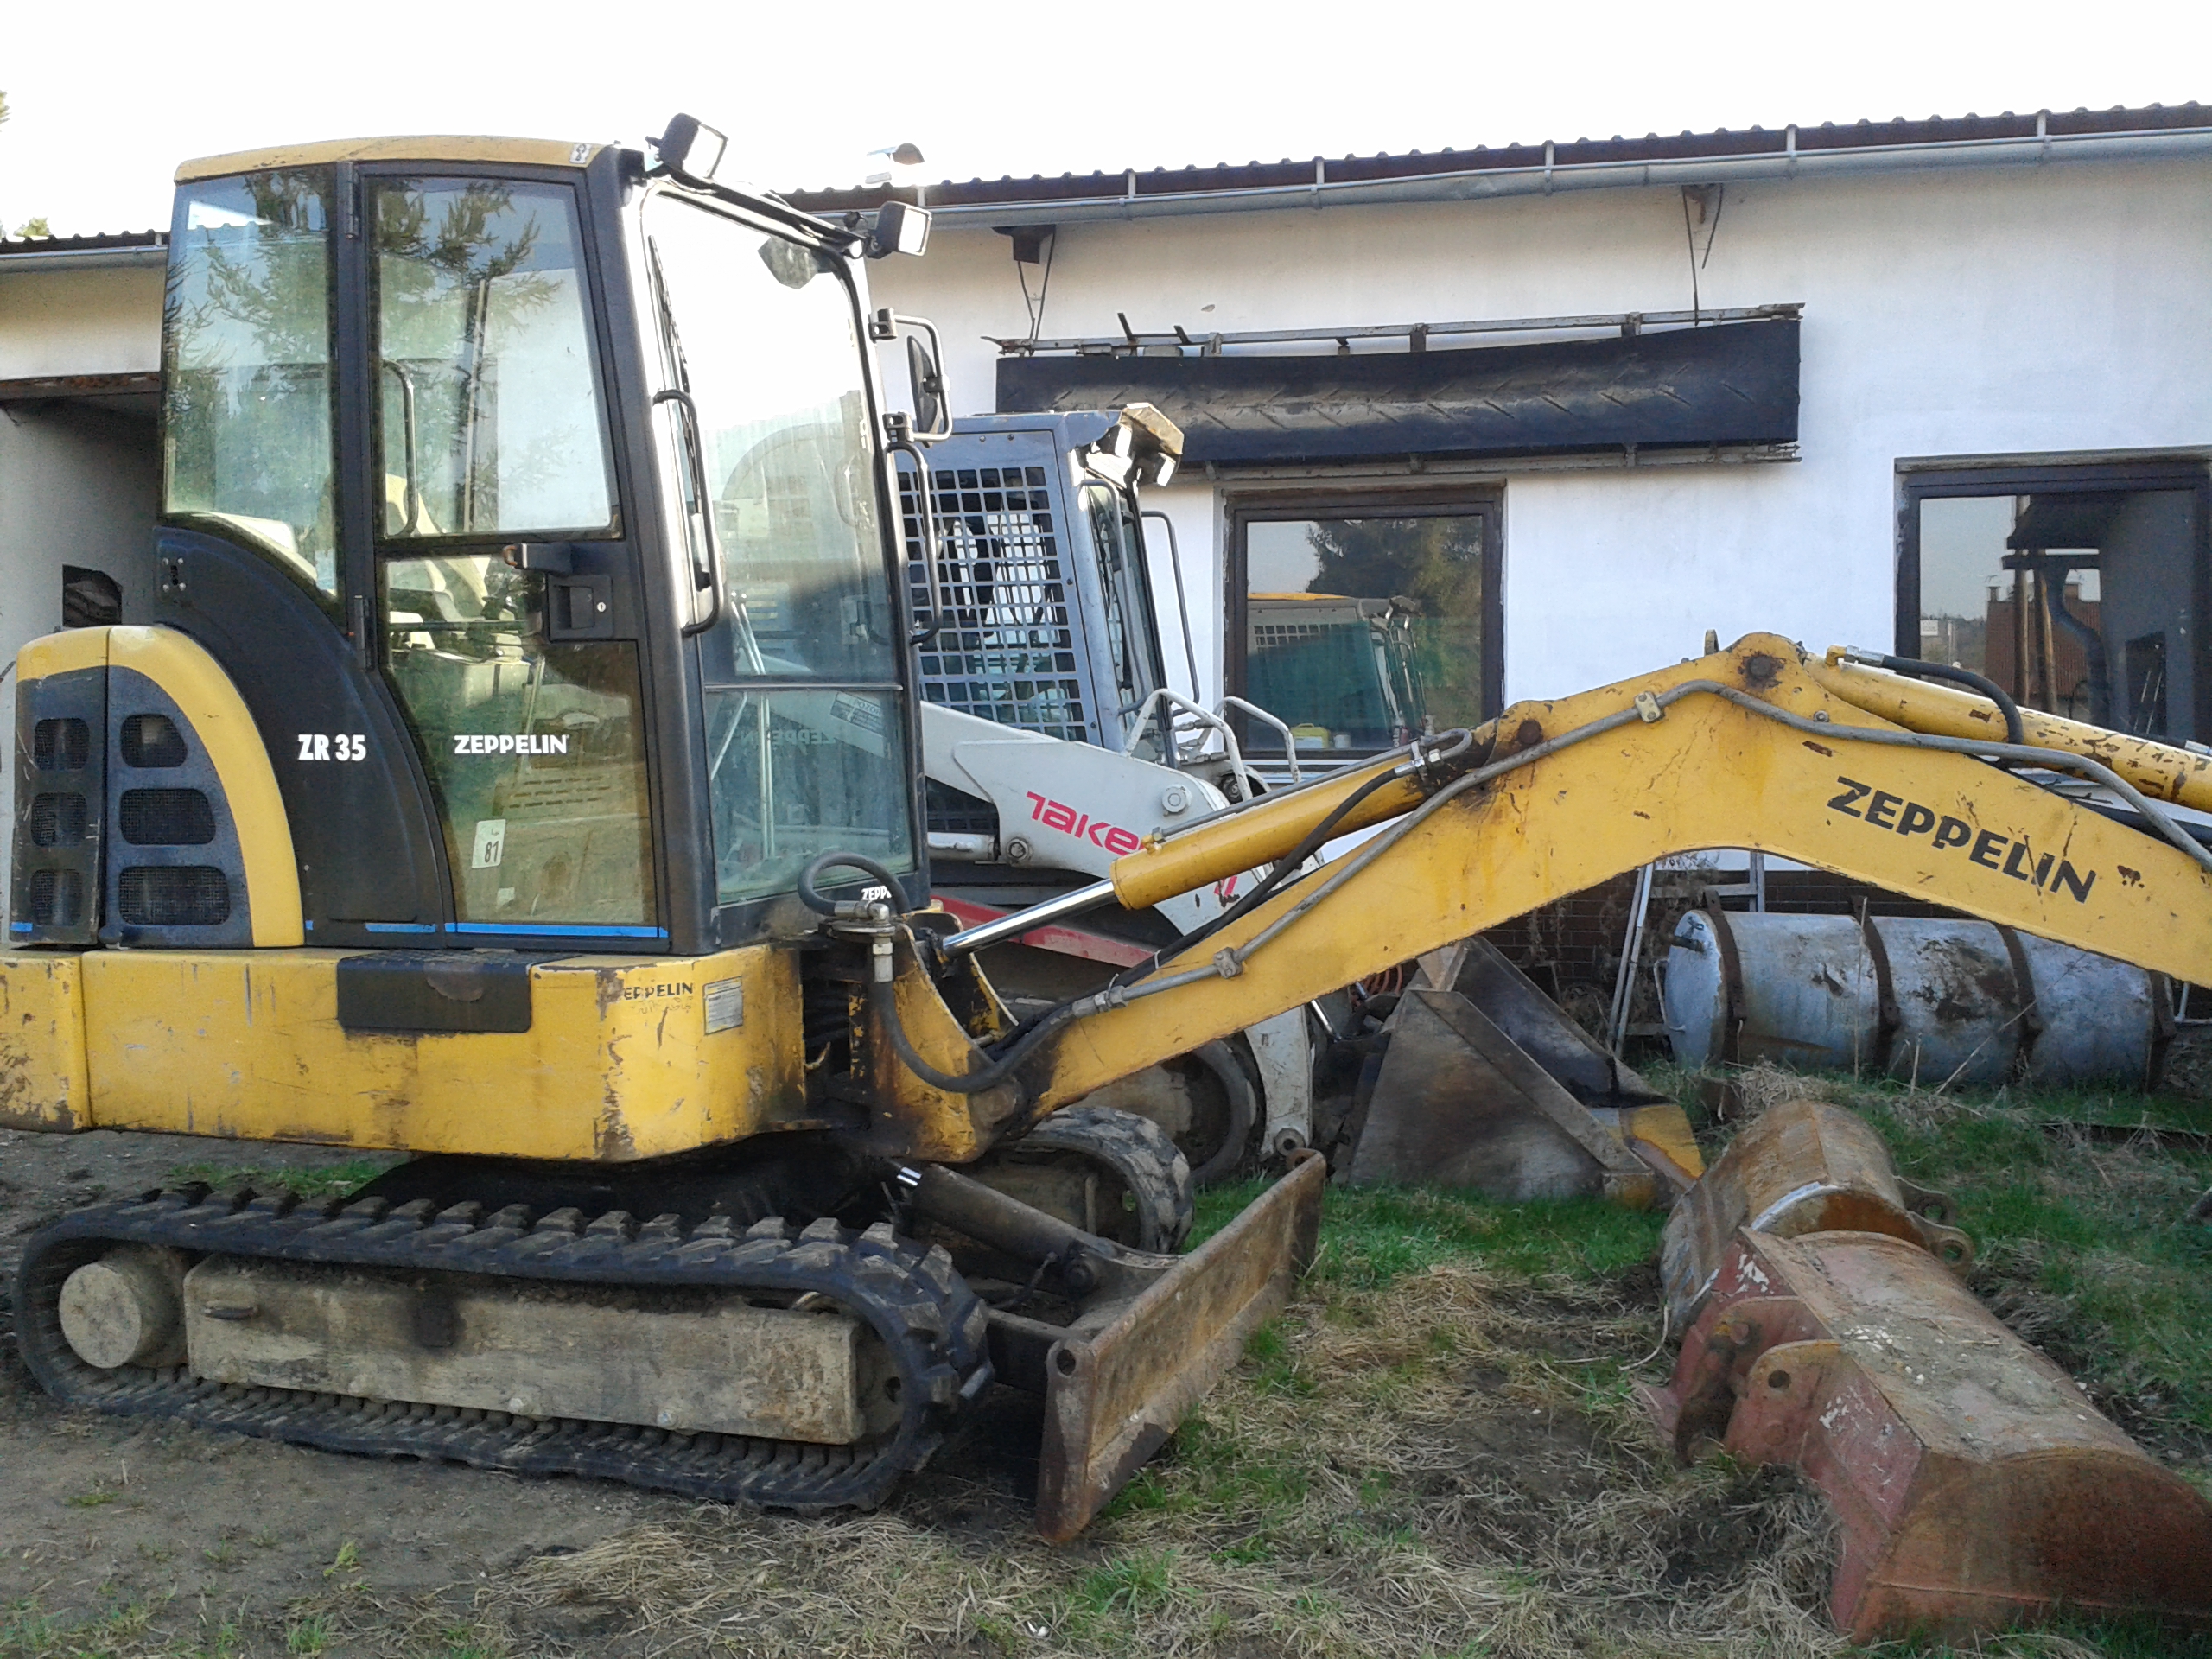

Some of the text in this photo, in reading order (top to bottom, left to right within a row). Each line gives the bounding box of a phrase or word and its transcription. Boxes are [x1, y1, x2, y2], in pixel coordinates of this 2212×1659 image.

[298, 734, 367, 762] ZR 35
[454, 734, 569, 754] ZEPPELIN
[1026, 791, 1146, 856] Take
[484, 840, 499, 863] 81
[1827, 775, 2097, 905] ZEPPELIN
[624, 982, 693, 1000] EPPELIN
